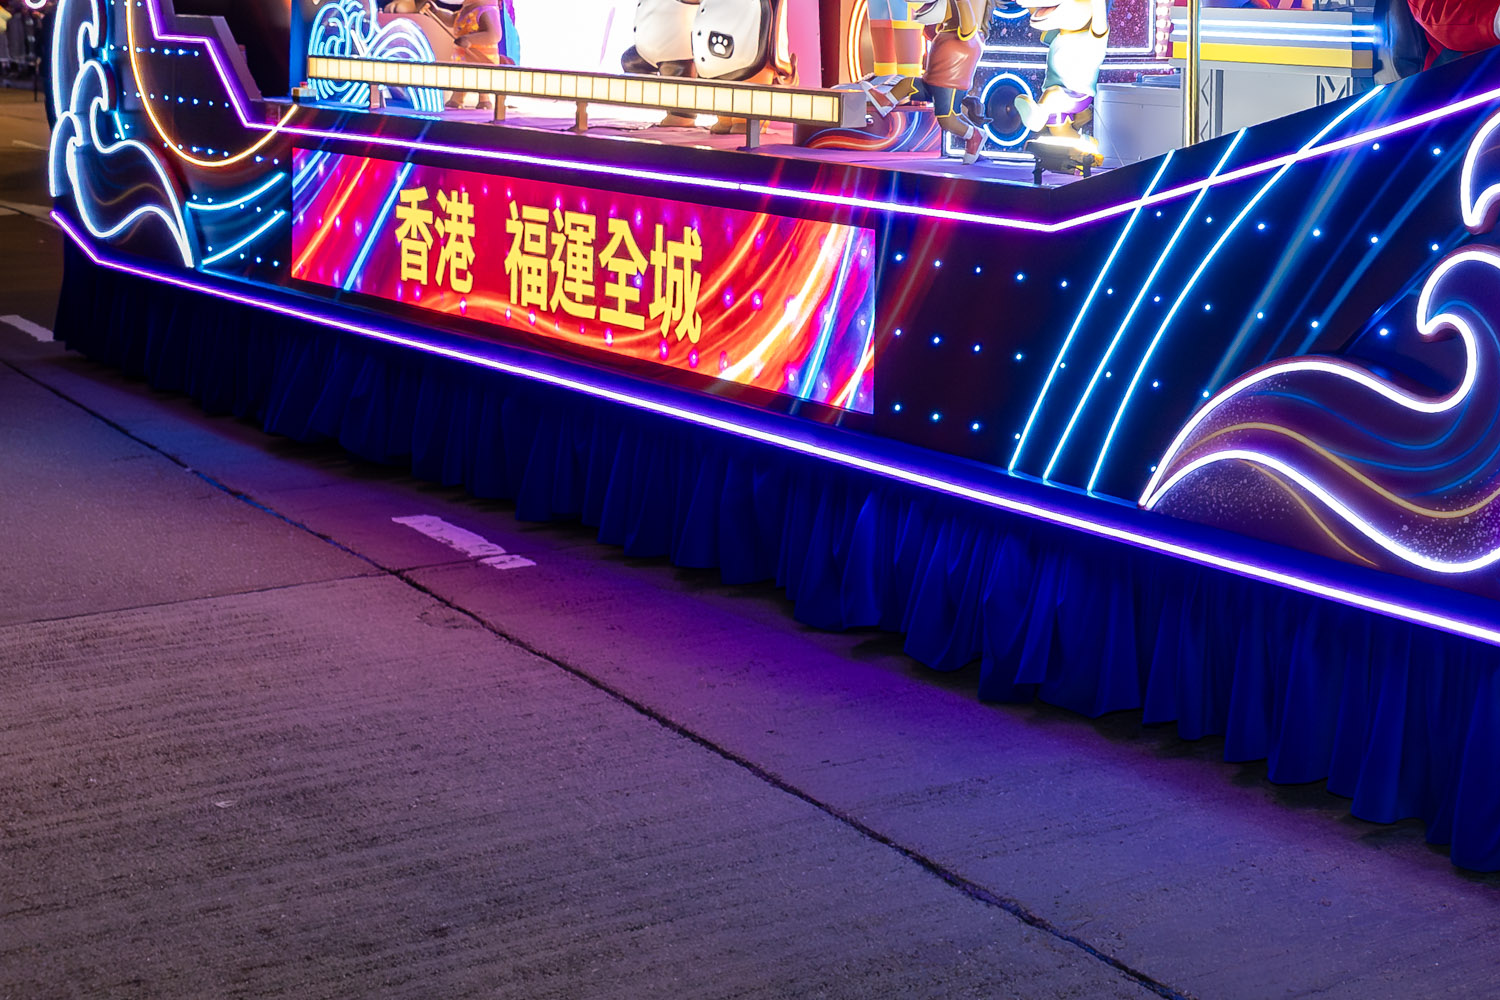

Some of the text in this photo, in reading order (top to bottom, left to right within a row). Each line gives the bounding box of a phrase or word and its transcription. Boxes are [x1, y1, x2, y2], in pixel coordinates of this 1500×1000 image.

[394, 187, 703, 344] 香港 福運全城
